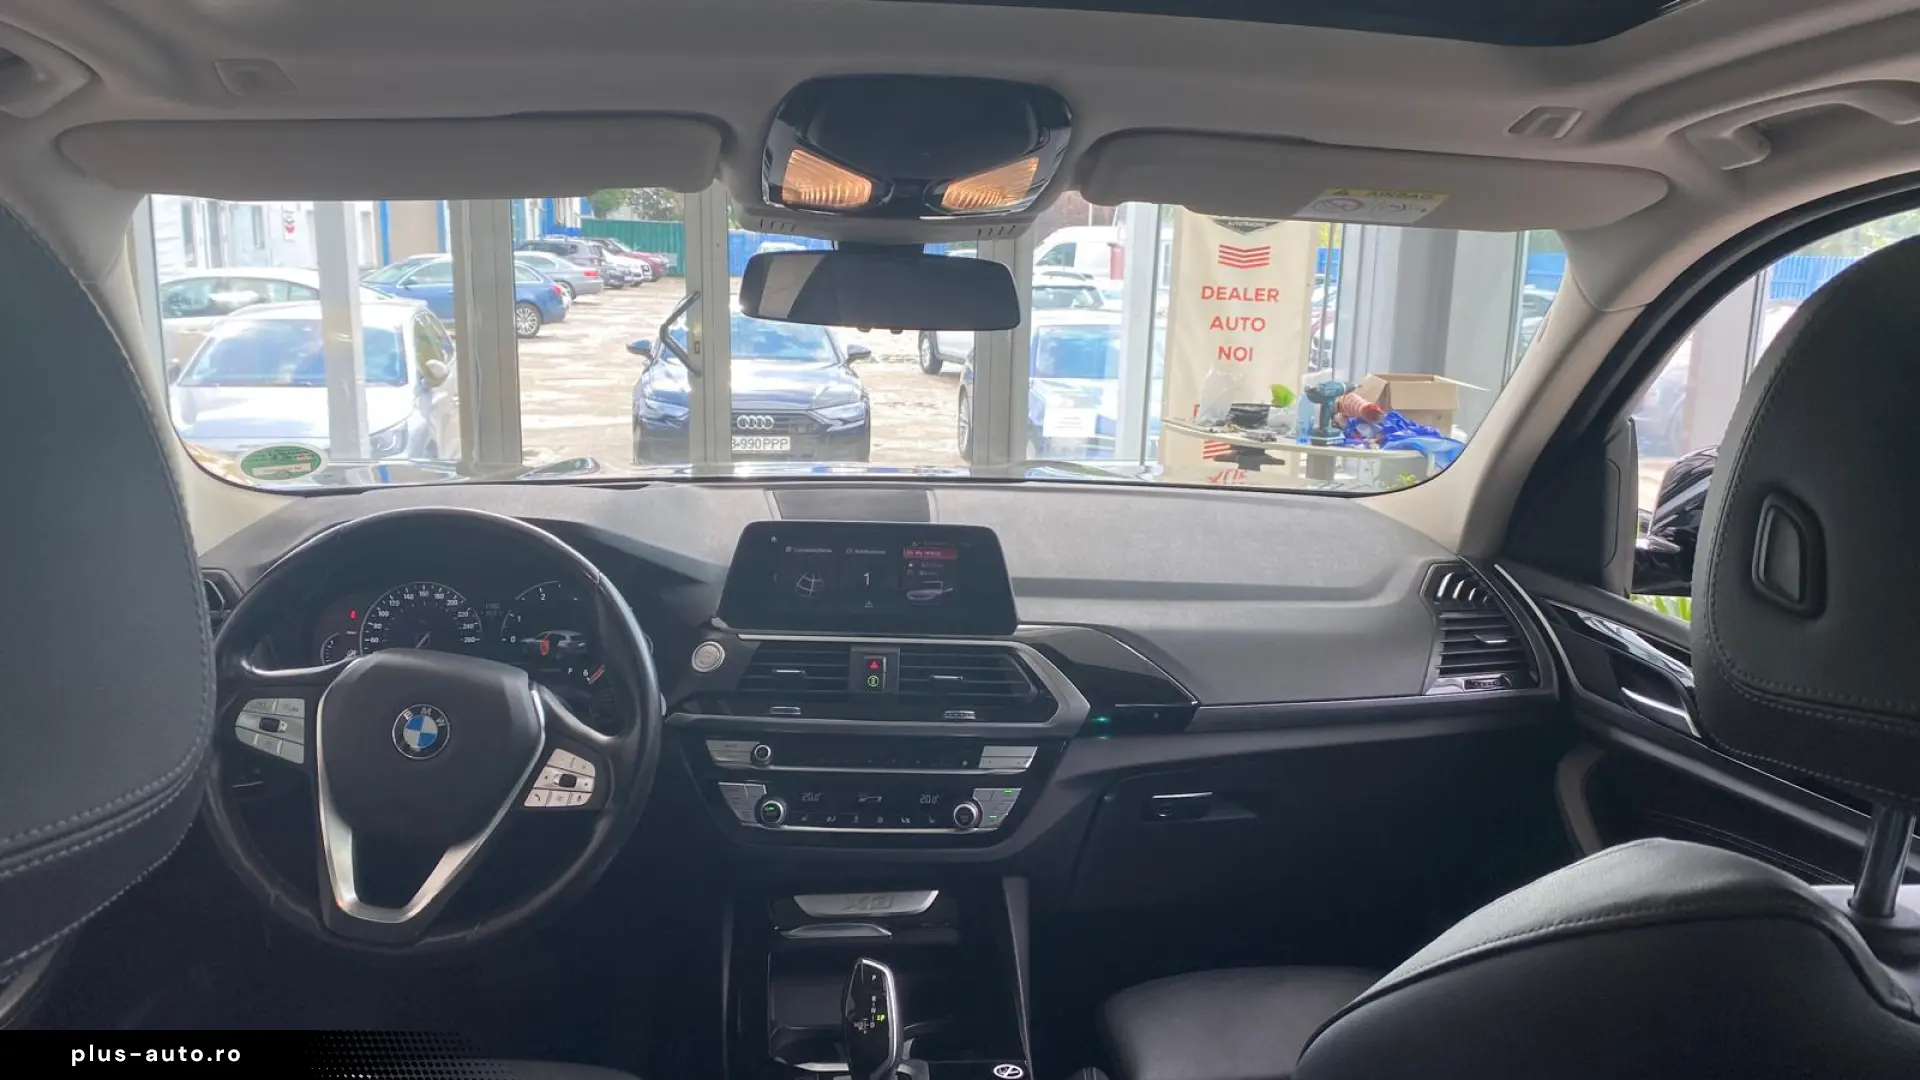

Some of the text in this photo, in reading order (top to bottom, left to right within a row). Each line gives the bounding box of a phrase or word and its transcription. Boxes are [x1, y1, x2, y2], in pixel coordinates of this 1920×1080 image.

[1200, 285, 1279, 303] DEALER
[1210, 315, 1266, 333] AUTO
[1218, 345, 1253, 362] NOI
[863, 572, 870, 586] 1
[403, 706, 446, 727] BMW
